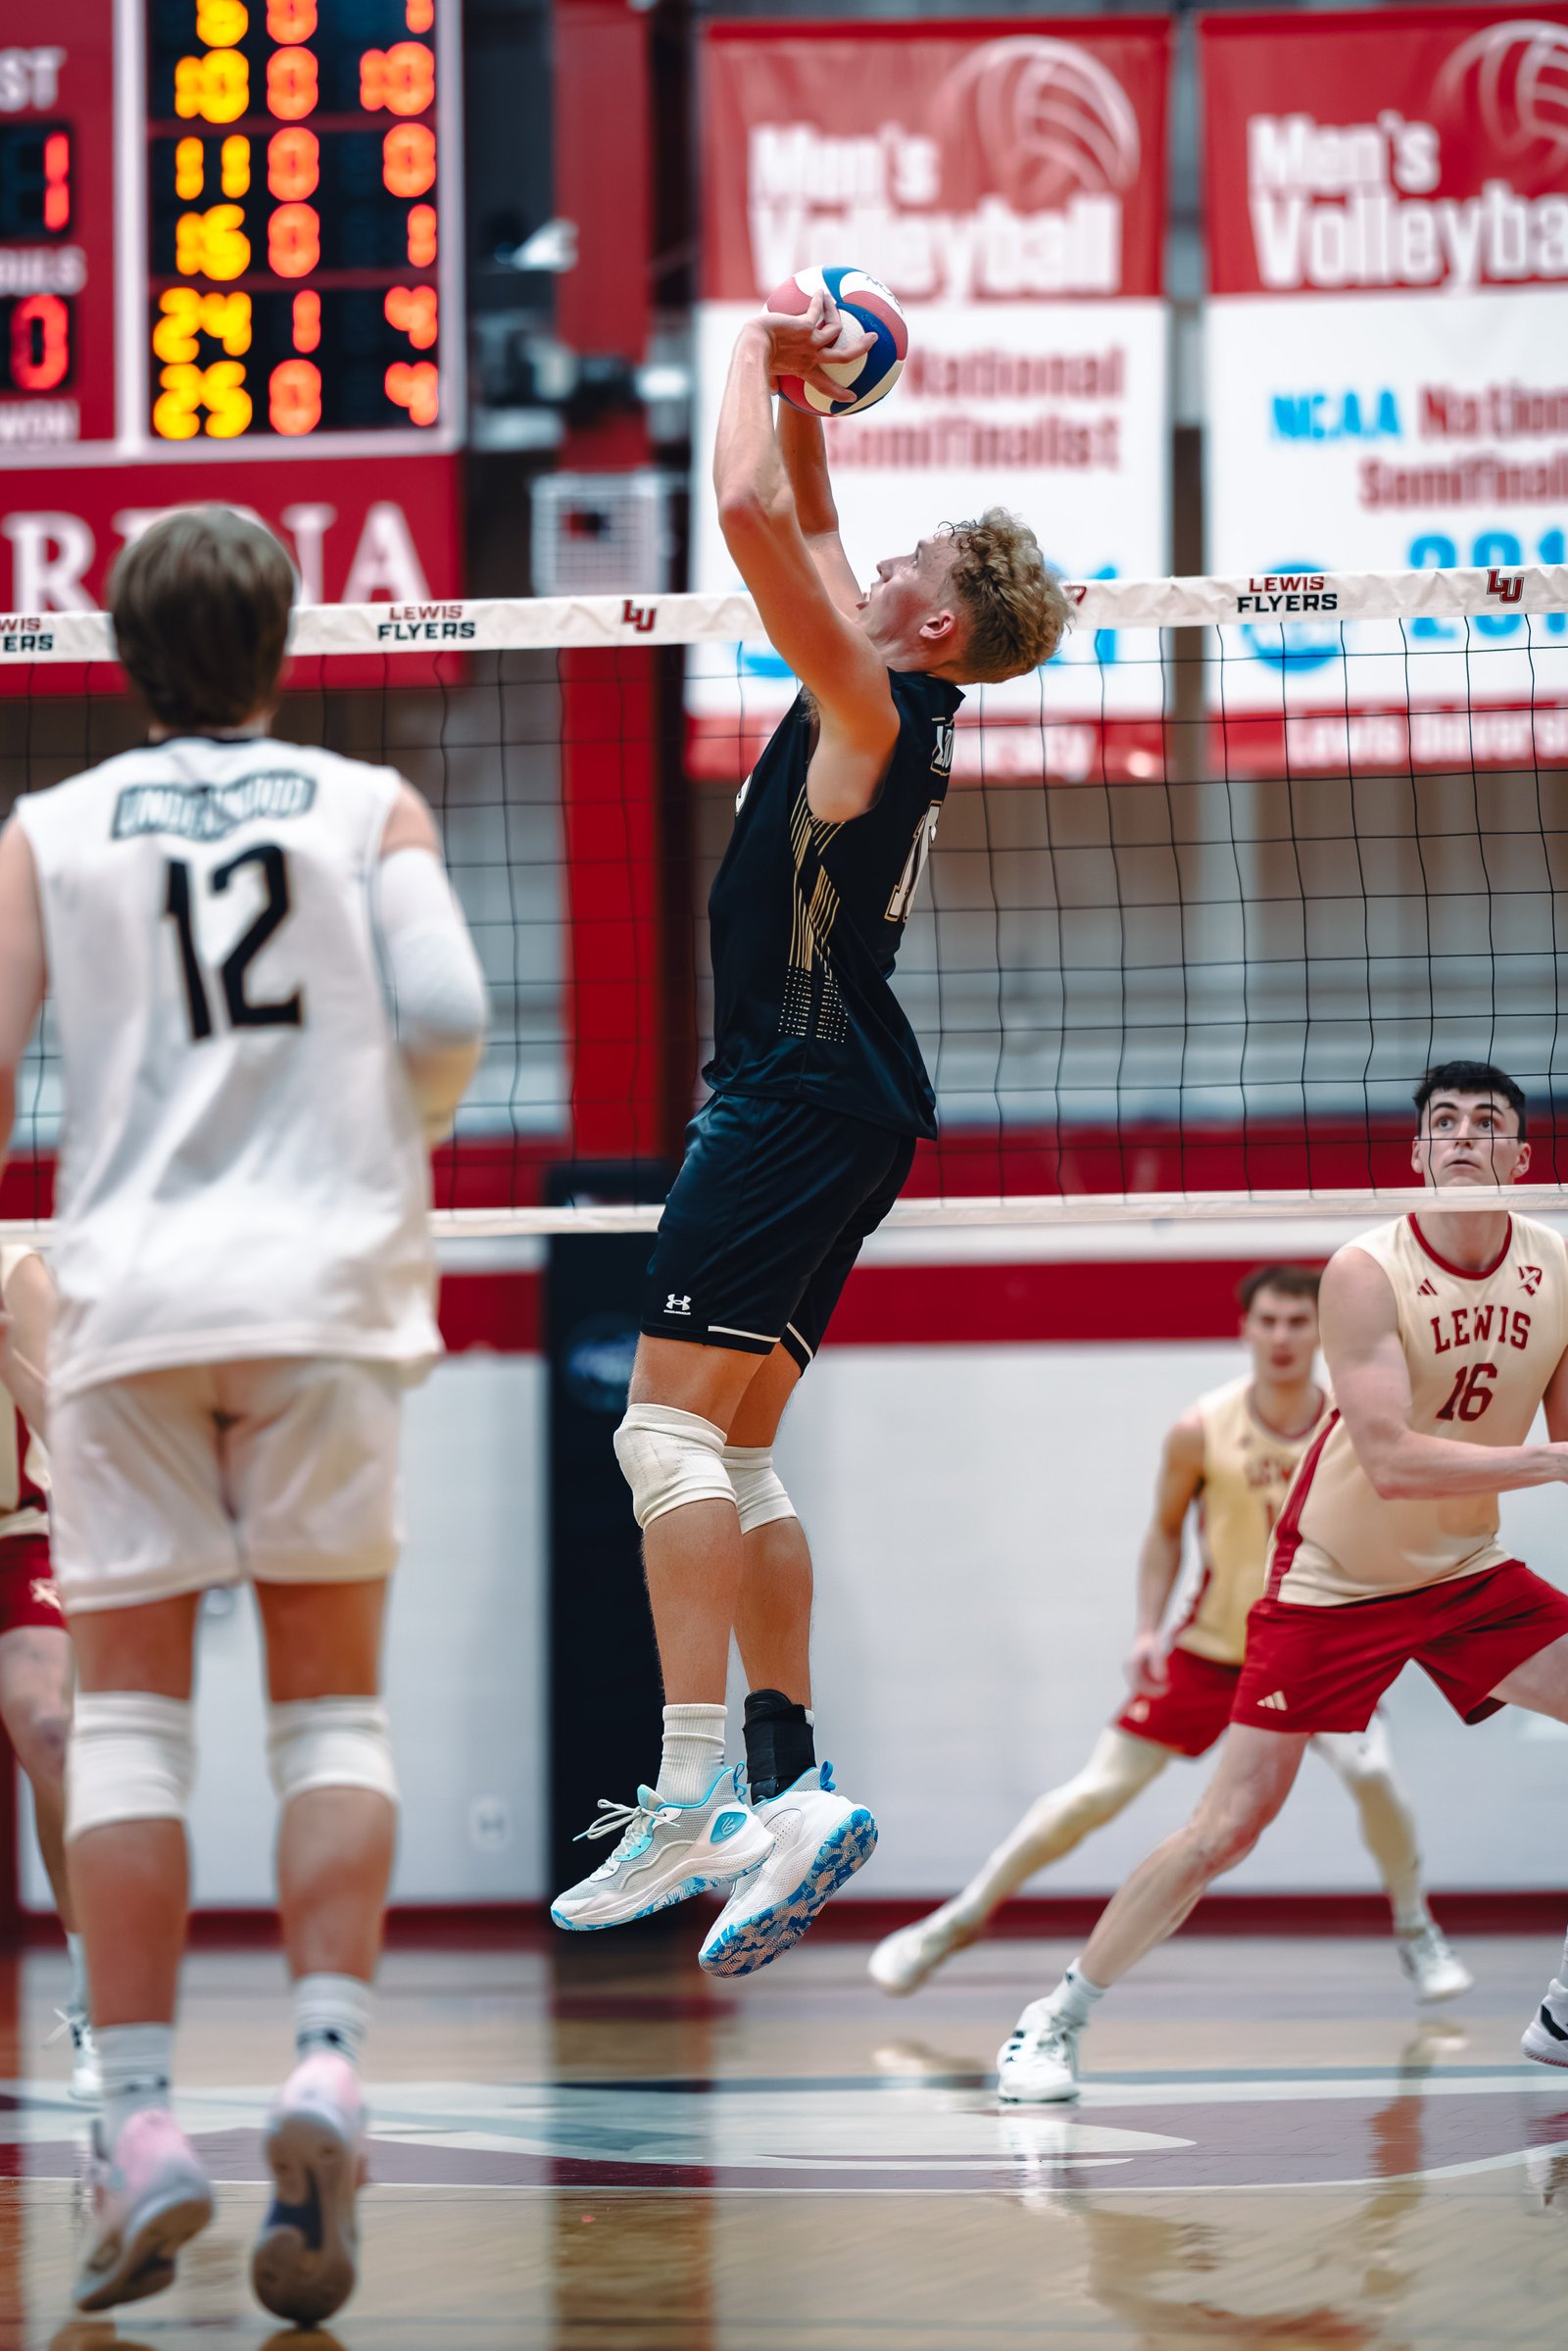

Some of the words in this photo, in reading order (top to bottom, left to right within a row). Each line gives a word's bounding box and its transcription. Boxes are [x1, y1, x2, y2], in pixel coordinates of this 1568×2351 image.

[44, 131, 70, 232] 1
[175, 134, 251, 200] 11
[750, 123, 939, 203] Men's
[1248, 111, 1441, 192] Men's
[750, 196, 1122, 306] Volleyball
[11, 294, 70, 390] 0
[153, 287, 252, 364] 24
[293, 290, 320, 354] 1
[384, 285, 437, 350] 4
[154, 361, 253, 439] 25
[384, 361, 438, 425] 4
[1272, 391, 1402, 440] NCAA
[389, 605, 463, 621] LEWIS
[1236, 593, 1338, 614] FLYERS
[1249, 575, 1325, 593] LEWIS
[0, 634, 54, 653] ERS
[376, 621, 476, 641] FLYERS
[162, 841, 306, 1042] 12
[1430, 1304, 1532, 1355] LEWIS
[1435, 1362, 1498, 1422] 16
